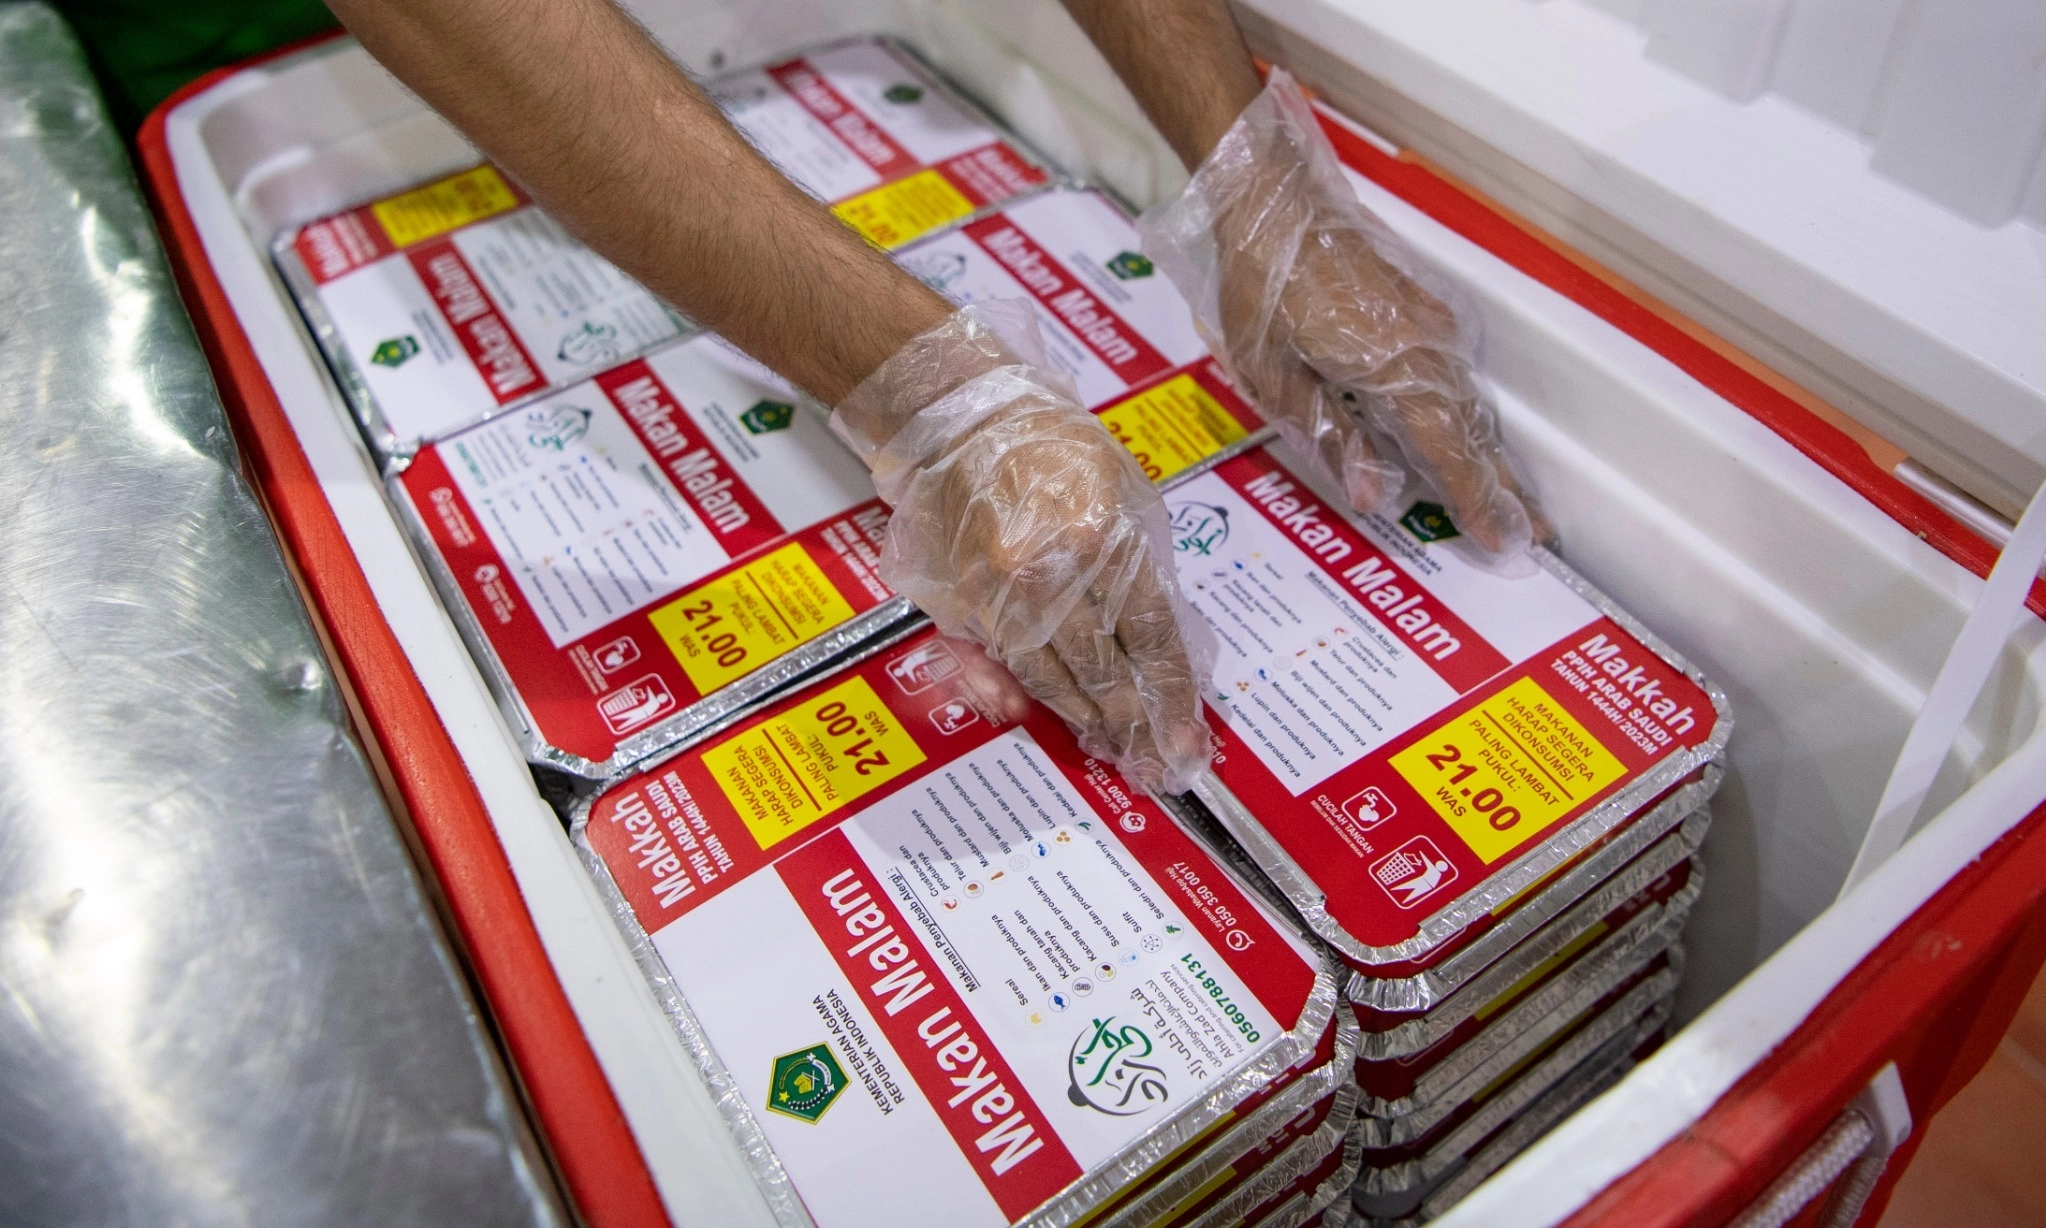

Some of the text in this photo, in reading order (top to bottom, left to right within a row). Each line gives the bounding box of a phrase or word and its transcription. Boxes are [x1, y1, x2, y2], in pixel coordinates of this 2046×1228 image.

[982, 226, 1063, 296] Makan
[1050, 288, 1138, 365] Malam
[613, 375, 688, 457] Makan
[669, 447, 750, 534] Malam
[1243, 470, 1461, 661] Makan Malam
[681, 599, 747, 668] 21.00
[1289, 669, 1366, 747] Biji wijen dan produknya
[1309, 659, 1383, 732] Mustard dan produknya
[1329, 648, 1392, 711] Telur dan produknya
[1550, 657, 1658, 755] TAHUN 1444H/2023M
[1561, 649, 1673, 747] PPIH ARAB SAUDI
[1577, 632, 1695, 735] Makkah
[807, 733, 839, 772] PUKUL:
[815, 700, 890, 775] 21.00
[863, 710, 889, 736] WAS
[1230, 703, 1301, 778] Kedelai dan produknya
[1249, 691, 1316, 760] Lupin dan produknya
[1270, 680, 1344, 756] Moluska dan produknya
[1501, 711, 1575, 782] DIKONSUMSI
[1506, 696, 1594, 782] HARAP SEGERA
[1533, 702, 1593, 758] MAKANAN
[726, 765, 769, 820] MAKANAN
[733, 744, 794, 826] HARAP SEGERA
[752, 744, 804, 809] DIKONSUMSI
[775, 723, 839, 801] PALING LAMBAT
[967, 761, 1000, 798] produknya
[996, 758, 1056, 829] Lupin dan produknya
[1012, 741, 1078, 817] Kedelai dan produknya
[1425, 743, 1521, 832] 21.00
[1468, 718, 1559, 806] PALING LAMBAT
[1477, 748, 1520, 792] PUKUL:
[644, 778, 718, 884] PPIH ARAB SAUDI
[662, 769, 734, 873] TAHUN 1444H/2023M
[925, 786, 990, 868] Mustard dan produknya
[944, 771, 1012, 854] Biji wijen dan produknya
[996, 796, 1010, 811] dan
[1007, 810, 1034, 842] Moluska
[1316, 793, 1374, 854] CUCILAH TANGAN
[1435, 785, 1467, 817] WAS
[609, 791, 696, 909] Makkah
[898, 844, 939, 897] Crustacea dan
[910, 808, 967, 881] Telur dan produknya
[917, 851, 951, 891] produknya
[1094, 838, 1165, 919] Seledri dan produknya
[1026, 874, 1097, 962] Kacang dan produknya
[1055, 869, 1120, 947] Susu dan produknya
[1121, 910, 1142, 933] Sulfit
[1172, 861, 1237, 926] 050 350 0017
[887, 872, 980, 992] Makanan Penyebab Alergi
[990, 913, 1051, 991] Ikan dan produknya
[1013, 909, 1069, 979] Kacang tanah dan
[1043, 929, 1081, 972] produknya
[812, 993, 843, 1034] AGAMA
[821, 867, 1044, 1176] Makan Malam
[1004, 977, 1029, 1006] Sereal
[1159, 970, 1234, 1058] Ahla Zad Company
[1180, 952, 1260, 1043] 0560788131
[826, 987, 905, 1104] REPUBLIK INDONESIA
[836, 1034, 893, 1115] KEMENTERIAN
